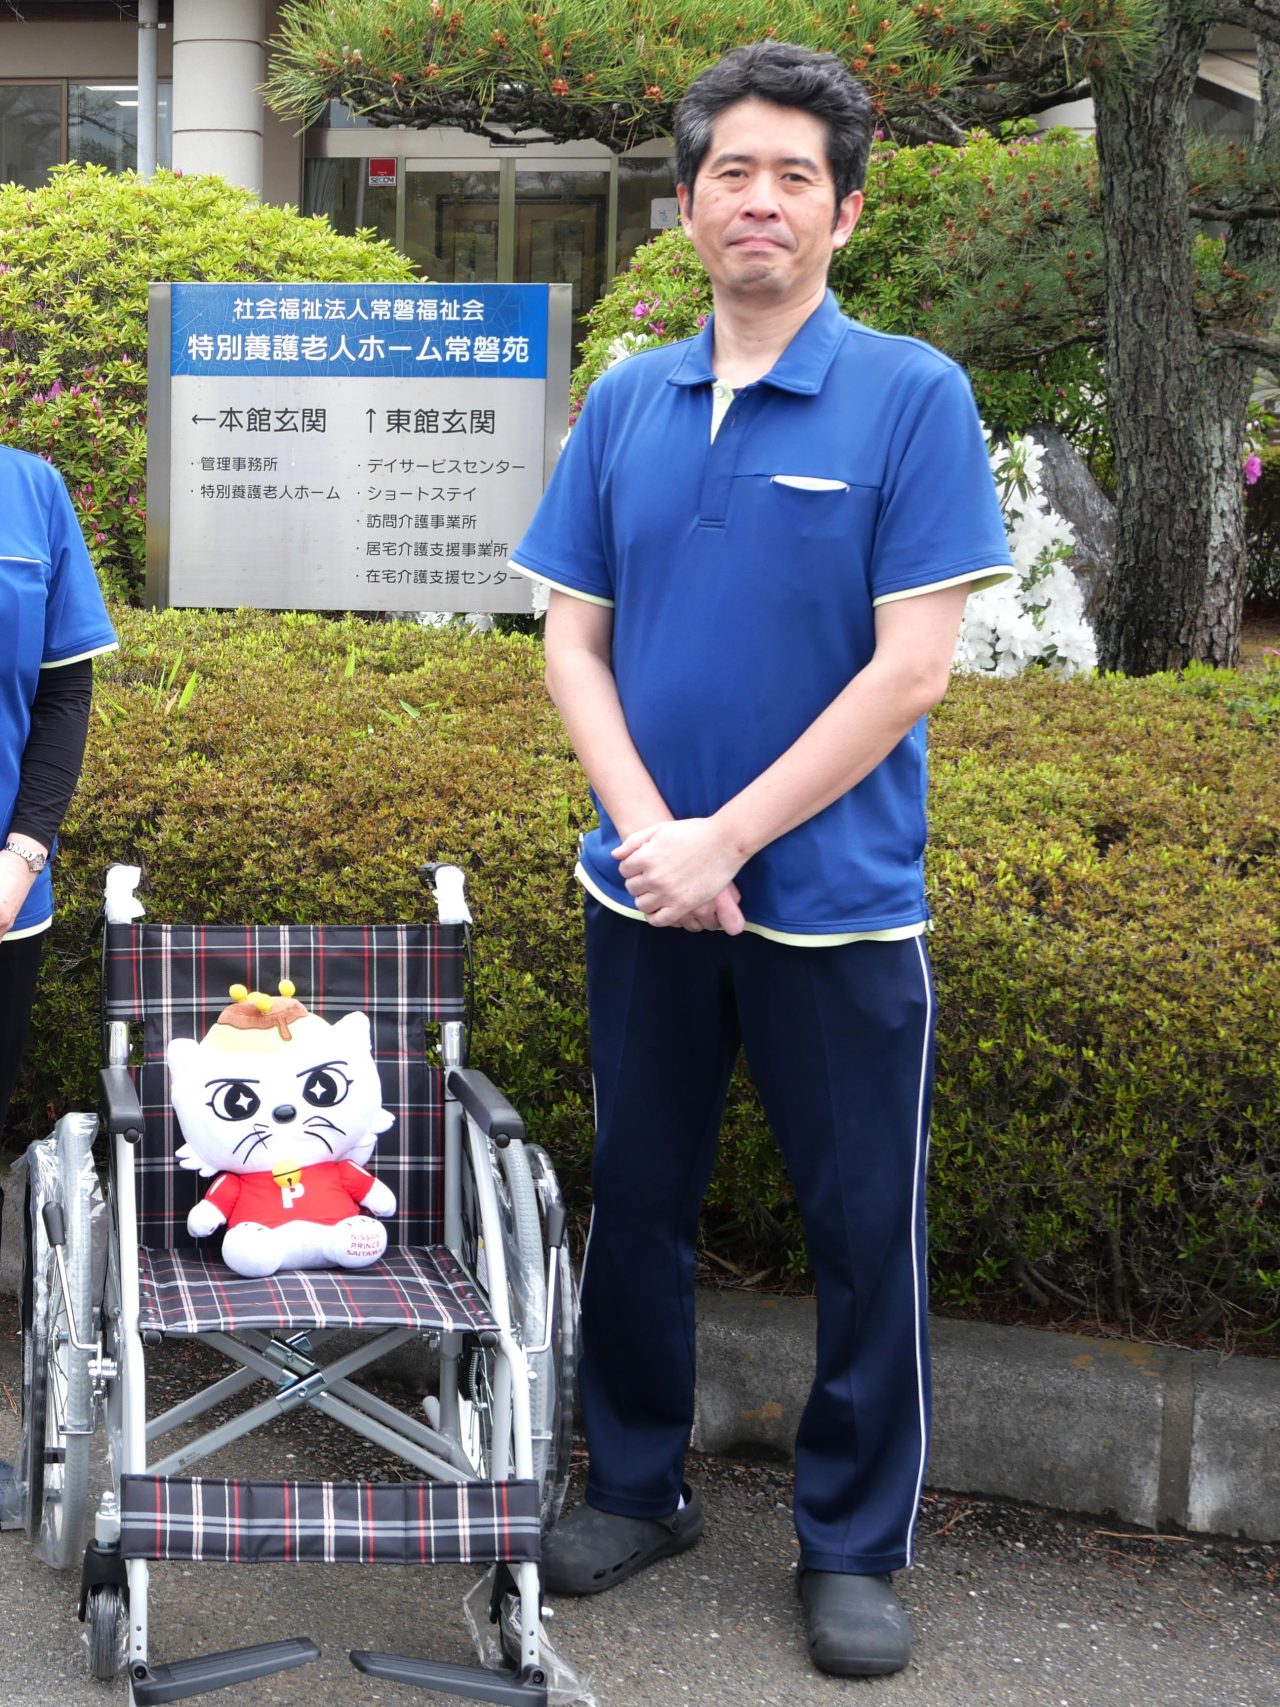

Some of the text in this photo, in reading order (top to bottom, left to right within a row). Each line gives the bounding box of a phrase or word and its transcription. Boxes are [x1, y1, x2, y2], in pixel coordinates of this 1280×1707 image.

[233, 298, 484, 321] 社会福祉法人常磐福祉会
[187, 334, 529, 363] 特別養護老人ホーム常磐苑
[219, 407, 327, 433] 本館玄関
[385, 408, 495, 434] 東館玄関
[200, 456, 278, 472] 管理事務所
[367, 458, 526, 474] デイサービスセンター
[200, 484, 341, 500] 特別養護老人ホーム
[367, 486, 476, 501] ショートステイ
[366, 513, 478, 529] 訪問介護事業所
[366, 541, 509, 557] 居宅介護支援事業所
[365, 569, 523, 585] 在宅介護支援センター
[281, 1182, 304, 1208] P
